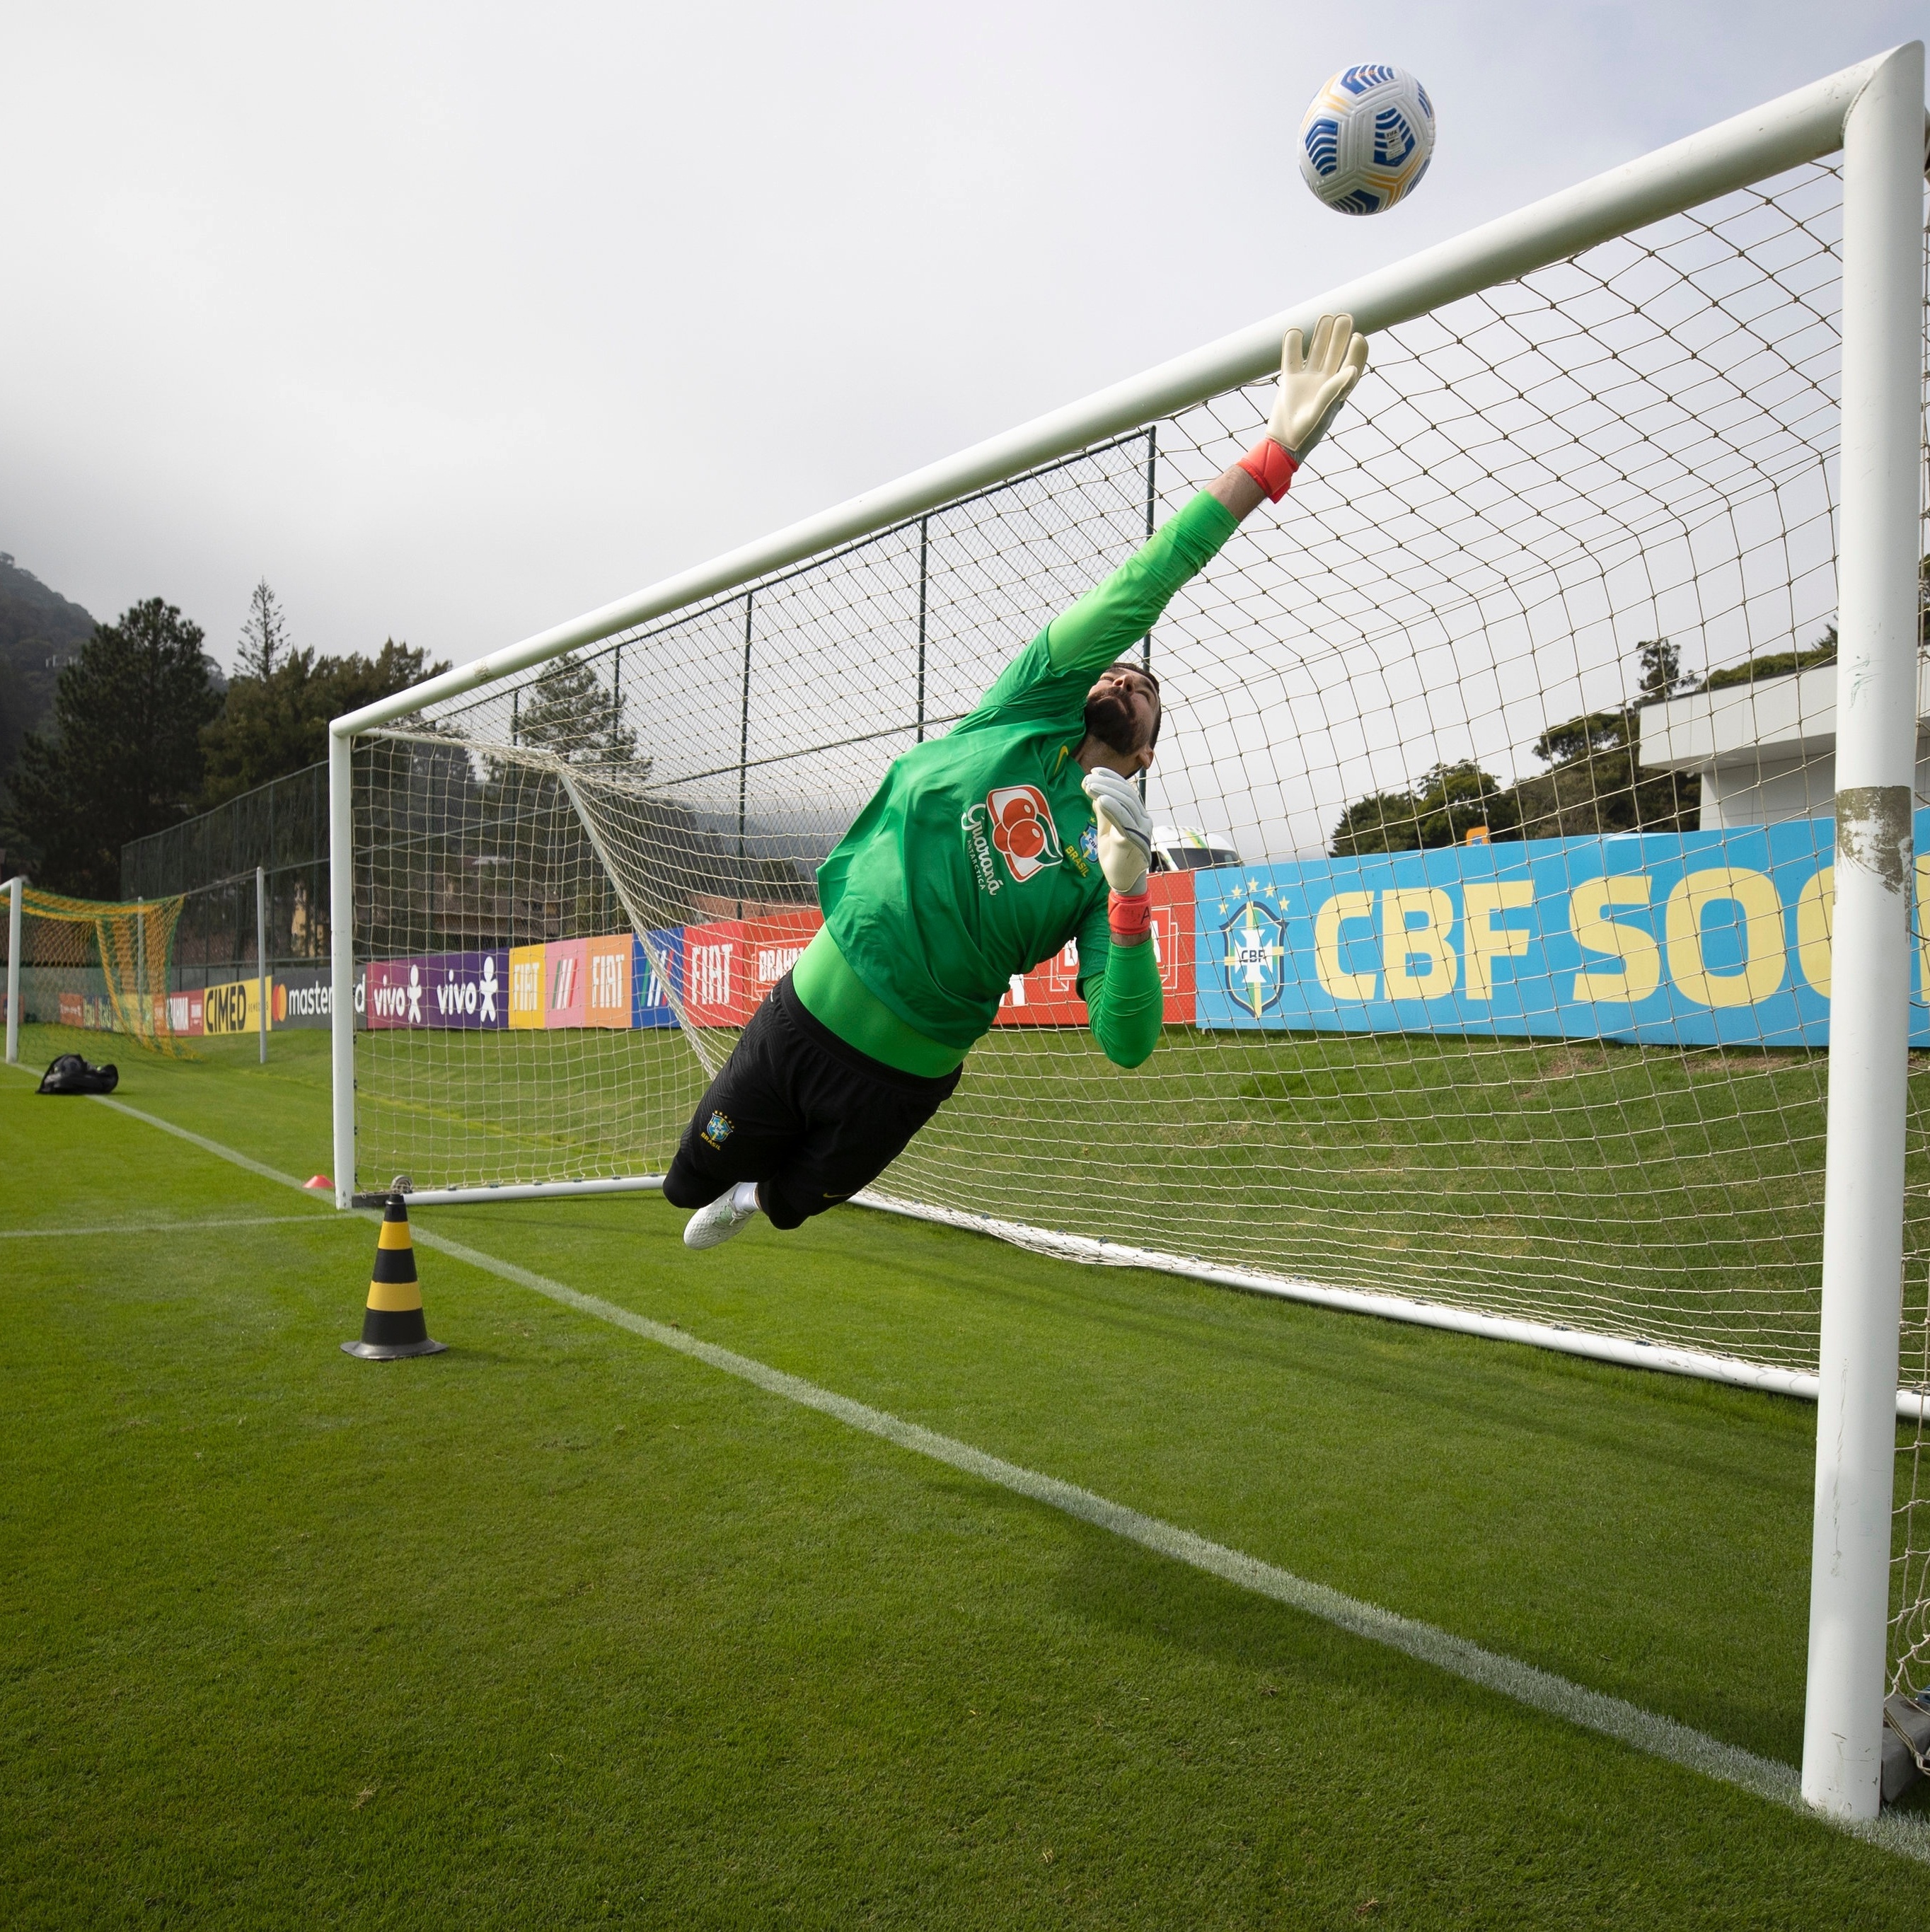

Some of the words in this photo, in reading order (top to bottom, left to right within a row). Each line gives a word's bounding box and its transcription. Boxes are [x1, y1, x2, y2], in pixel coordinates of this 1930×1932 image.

[961, 803, 1004, 896] Guaraná
[967, 839, 986, 890] ANTARCTICA
[1065, 845, 1089, 878] BRASIL
[1241, 949, 1266, 963] CBF
[1314, 880, 1535, 1000] CBF
[1568, 856, 1930, 1008] SO
[289, 973, 365, 1016] masterd
[374, 974, 405, 1017] vivo
[437, 968, 476, 1015] vivo
[514, 962, 540, 1011] FIAT
[592, 954, 625, 1008] FIAT
[691, 943, 733, 1005] FIAT
[206, 984, 246, 1033] CIMED
[700, 1132, 721, 1150] BRASIL
